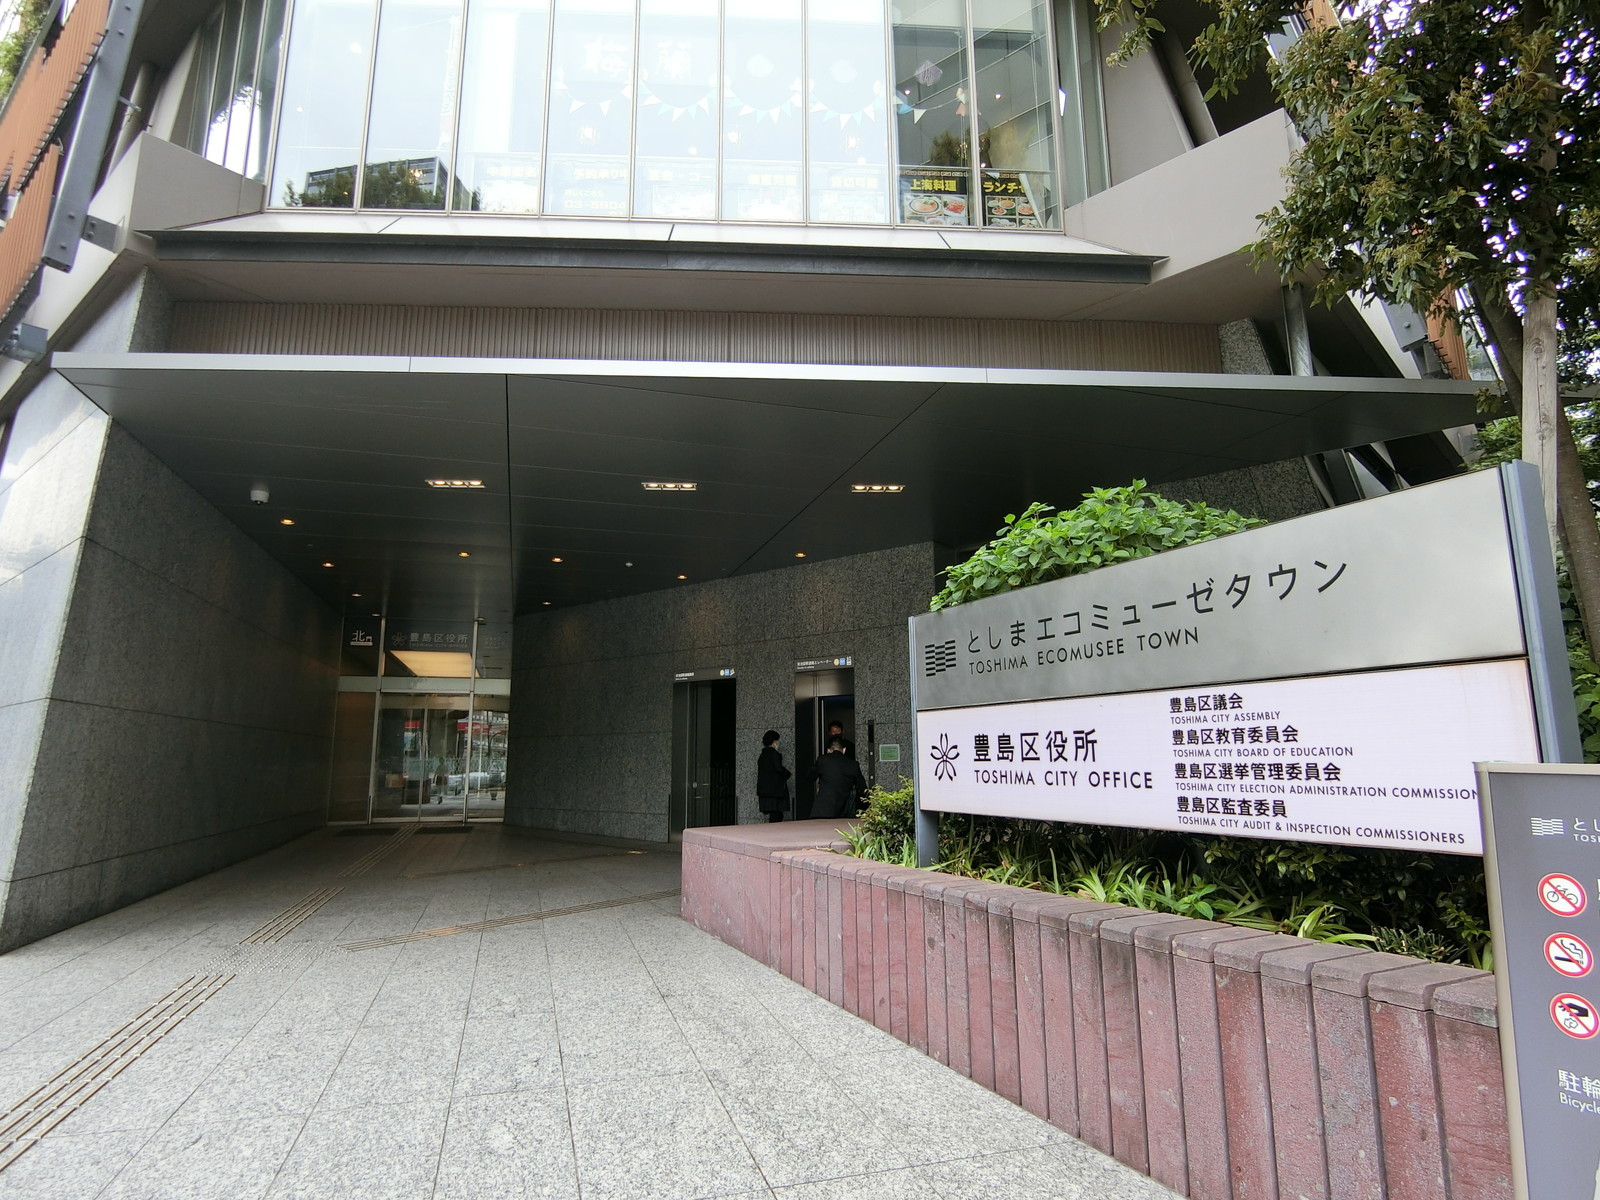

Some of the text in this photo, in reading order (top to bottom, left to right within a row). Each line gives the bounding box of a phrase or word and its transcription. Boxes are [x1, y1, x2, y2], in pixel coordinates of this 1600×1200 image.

[909, 178, 957, 192] 上海料理
[968, 560, 1348, 655] としまエコミューゼタウン
[969, 626, 1200, 676] TOSHIMA ECOMUSEE TOWN
[1169, 692, 1243, 713] 豊島区議会
[1171, 711, 1281, 725] TOSHIMA CITY ASSEMBLY
[974, 729, 1098, 763] 豊島区役所
[1172, 725, 1299, 746] 豊島区教育委員会
[1173, 746, 1353, 758] TOSHIMA CITY BOARD OF EDUCATION
[974, 769, 1153, 789] TOSHIMA CITY OFFICE
[1174, 762, 1341, 782] 豊島区選挙管理委員会
[1175, 782, 1477, 800] TOSHIMA CITY ELECTION ADMINISTRATION COMMISSION
[1177, 796, 1288, 818] 豊島区監査委員
[1178, 816, 1465, 845] TOSHIMA CITY AUDIT & INSPECTION COMMISSIONERS
[1558, 1069, 1600, 1099] 駐輪
